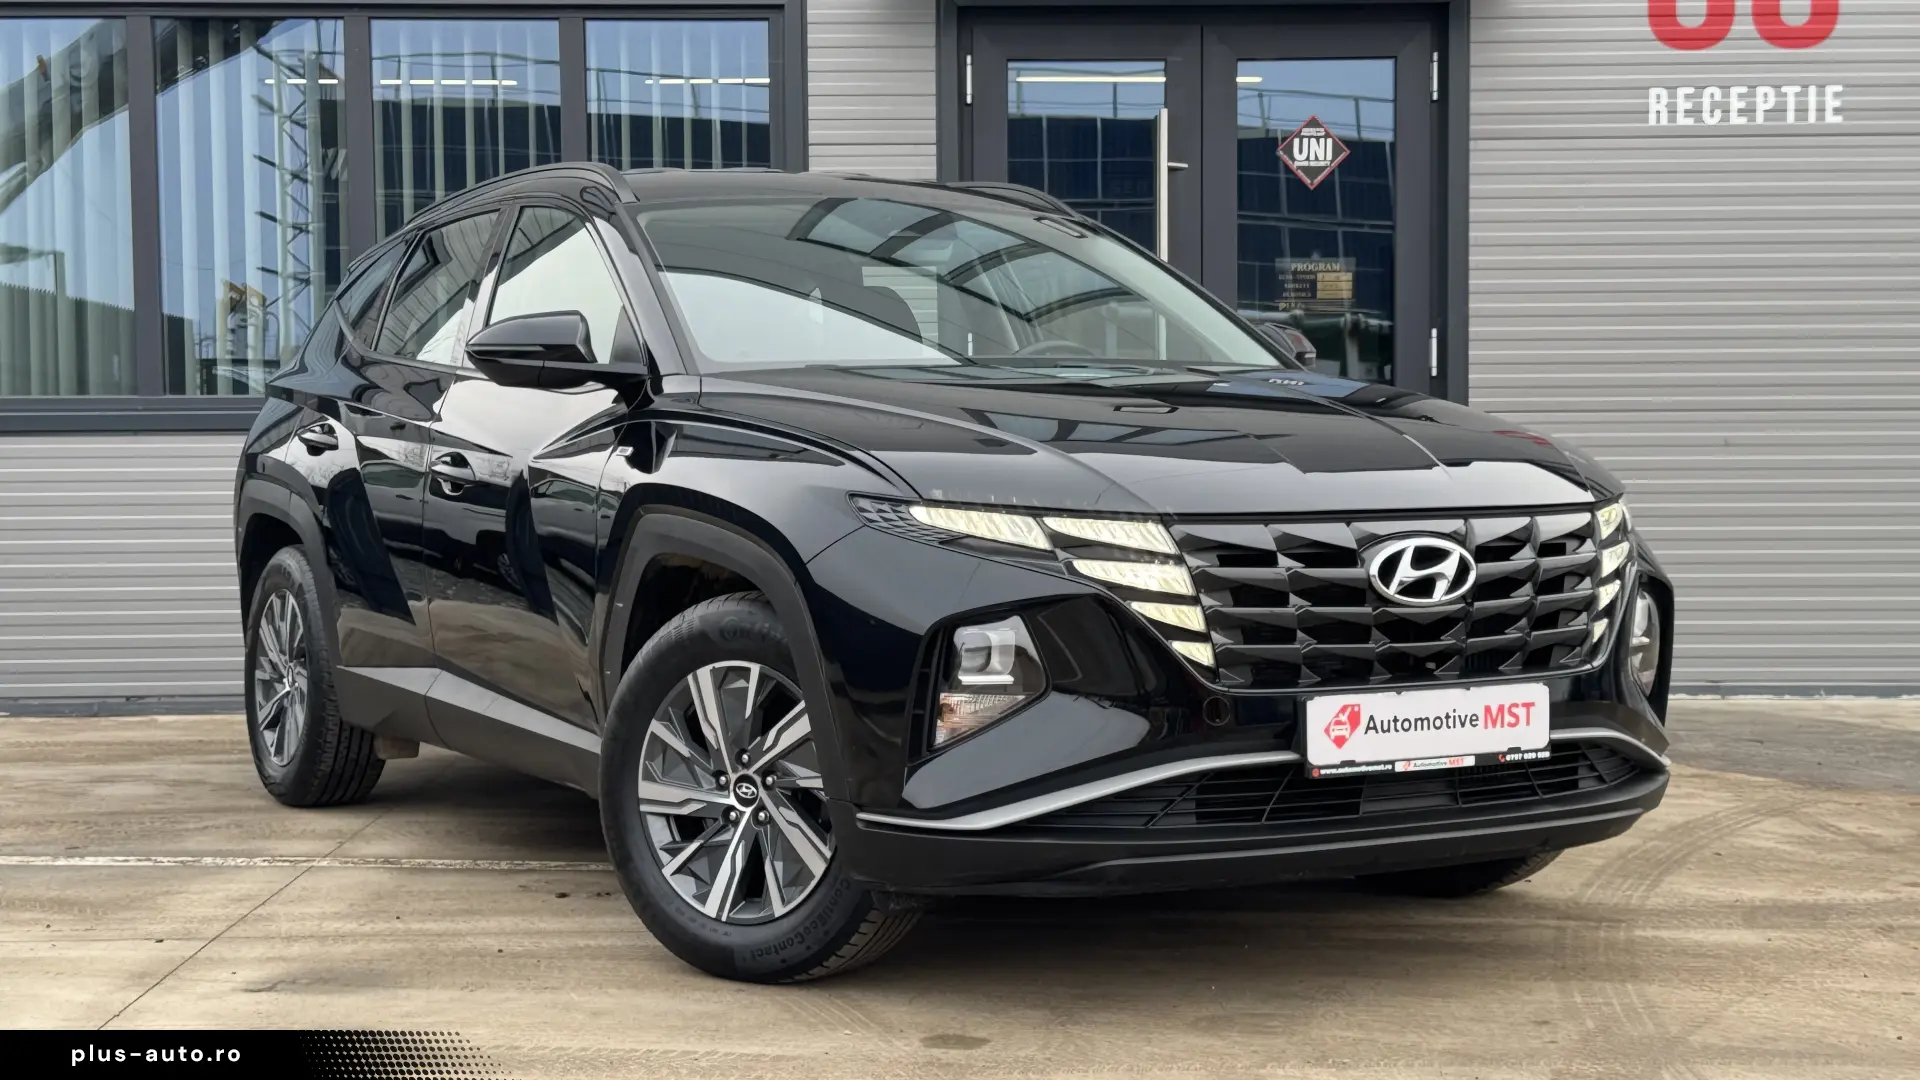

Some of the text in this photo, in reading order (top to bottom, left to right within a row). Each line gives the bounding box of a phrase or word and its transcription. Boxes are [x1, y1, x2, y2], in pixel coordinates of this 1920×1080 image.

[1648, 84, 1843, 125] RECEPTIE
[1292, 137, 1333, 161] UNI
[1290, 262, 1340, 271] PROGRAM
[1364, 702, 1536, 735] Automotive MST
[1448, 757, 1465, 767] MST
